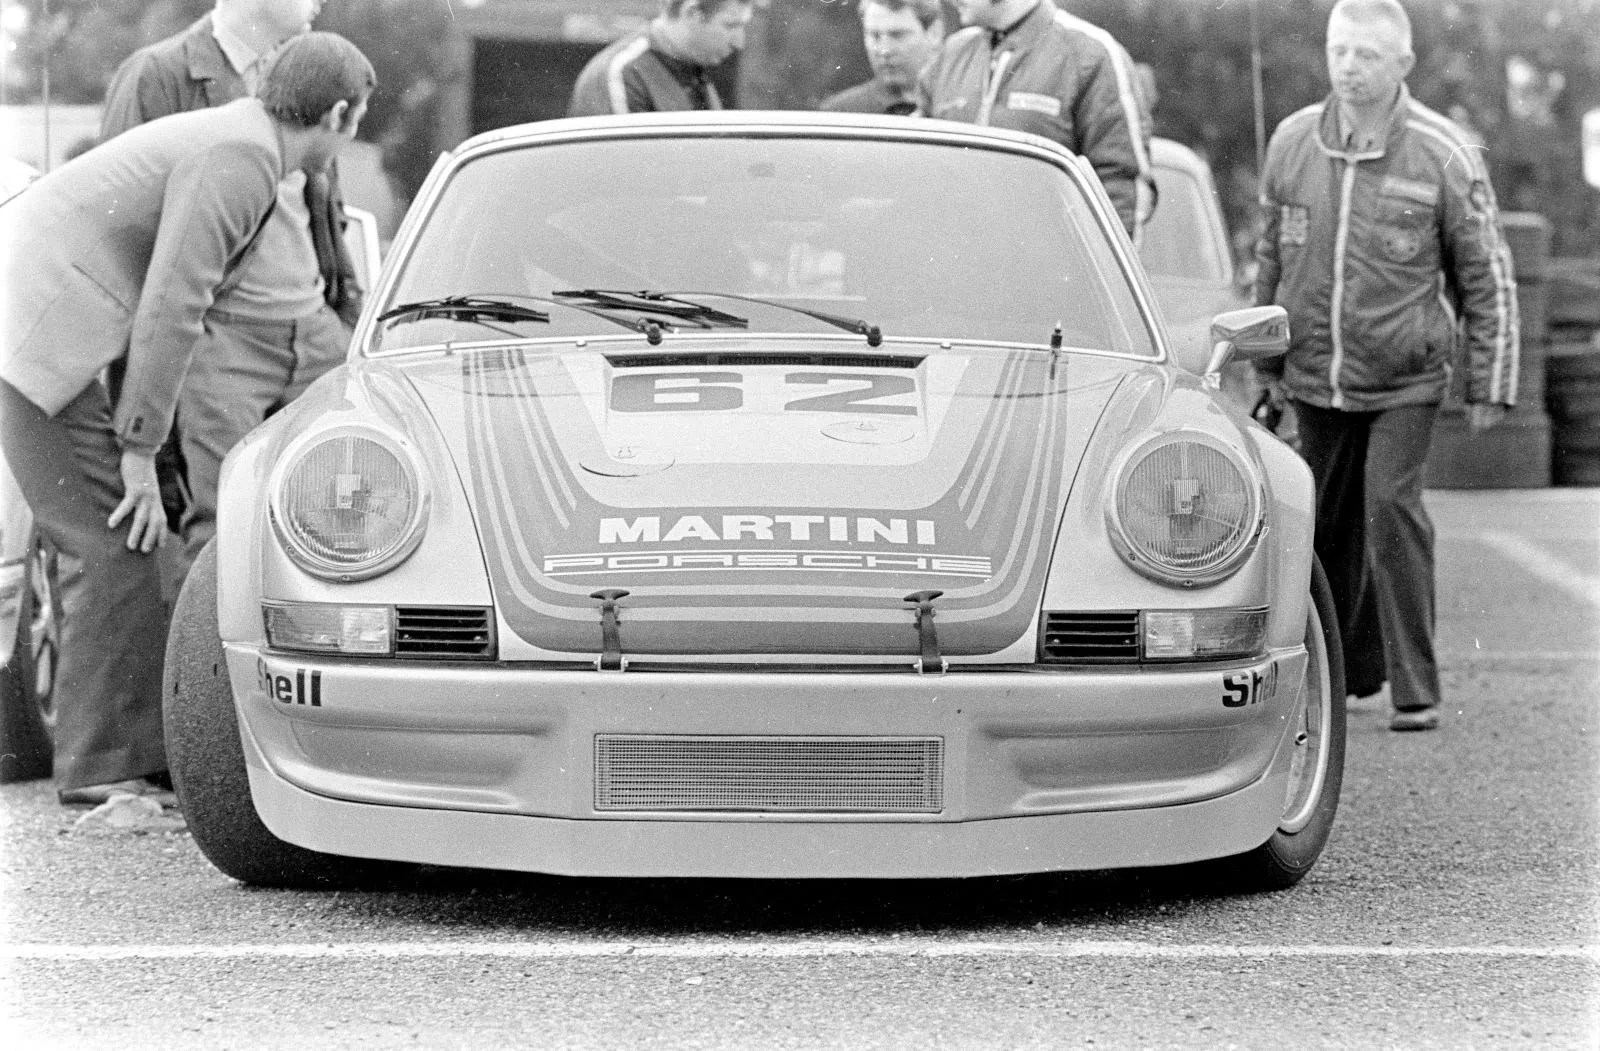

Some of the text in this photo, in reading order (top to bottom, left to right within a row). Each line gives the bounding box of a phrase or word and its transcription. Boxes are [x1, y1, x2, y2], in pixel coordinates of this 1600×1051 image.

[611, 371, 918, 416] 62
[599, 514, 936, 545] MARTINI
[543, 554, 992, 573] PORSCHE
